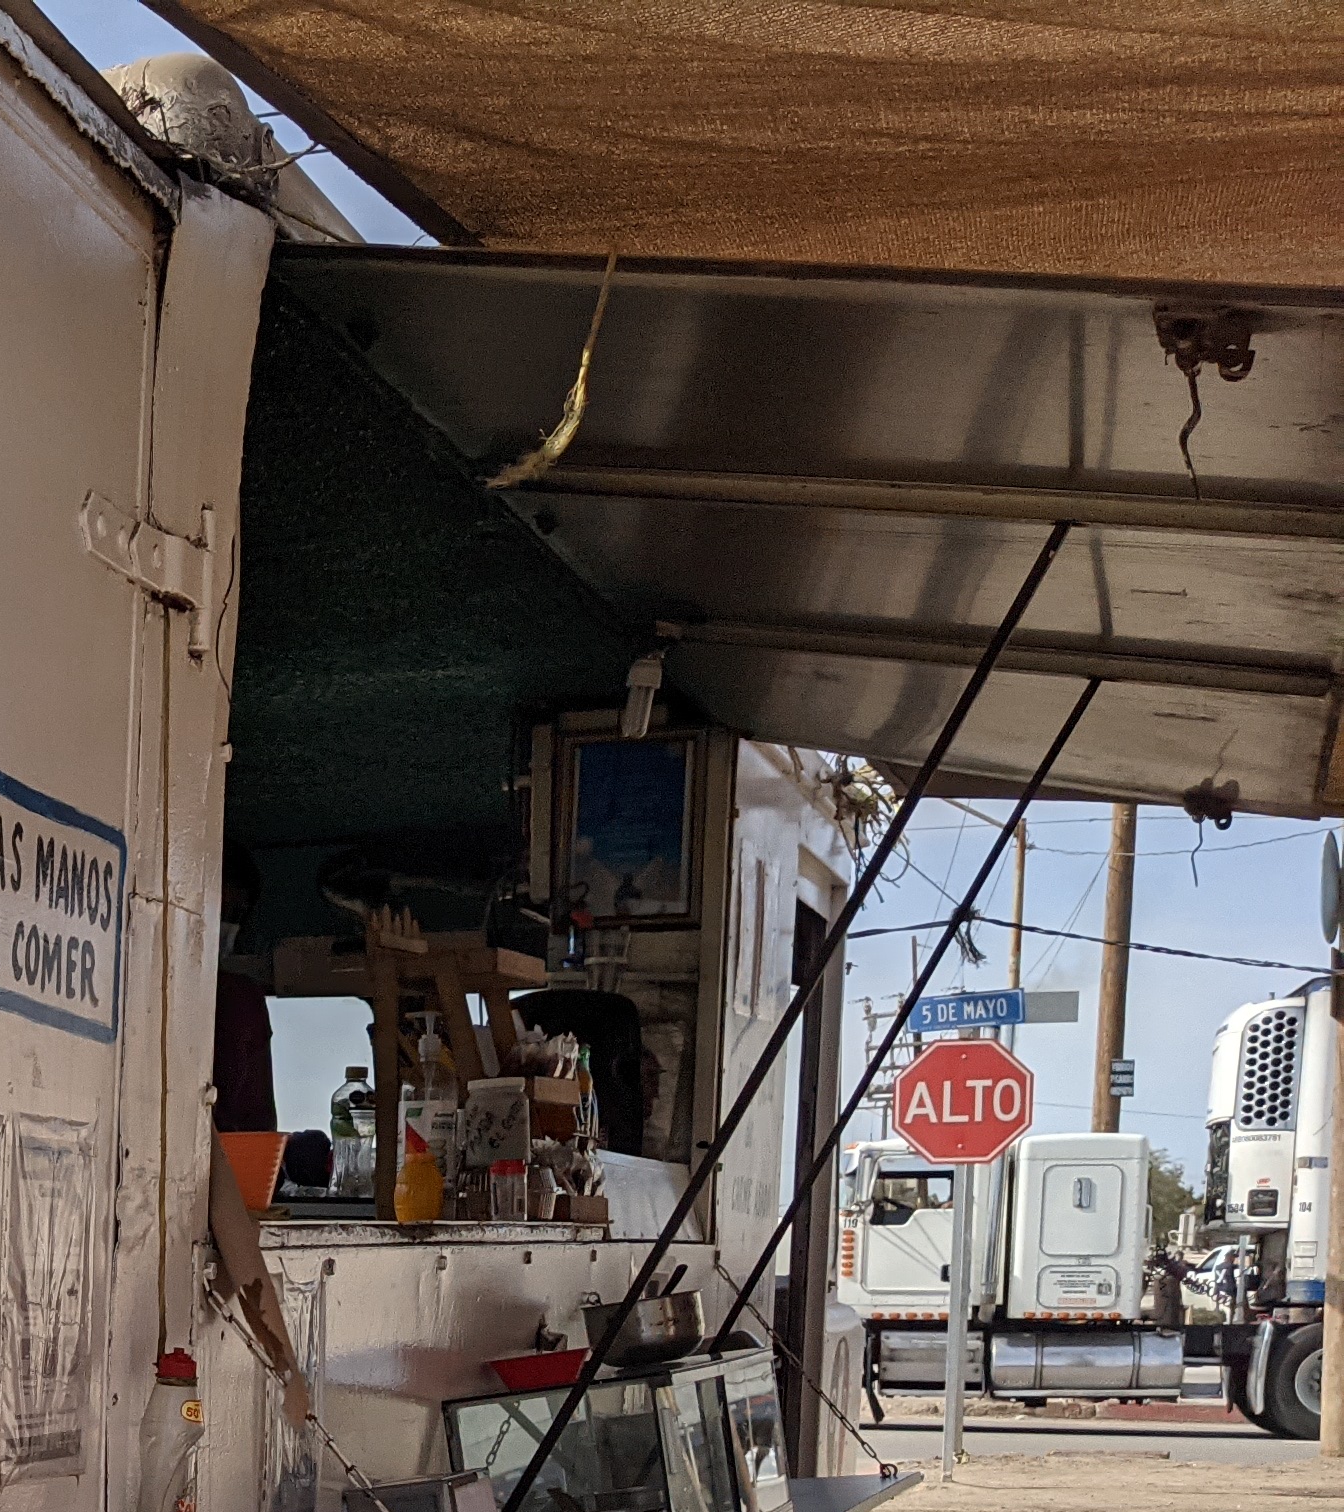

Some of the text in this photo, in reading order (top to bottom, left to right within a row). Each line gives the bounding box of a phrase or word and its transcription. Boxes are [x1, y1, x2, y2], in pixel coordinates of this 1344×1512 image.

[35, 834, 113, 932] MANOS
[12, 920, 98, 1008] COMER
[922, 997, 1008, 1024] 5 DE MAYO
[903, 1078, 1021, 1124] ALTO
